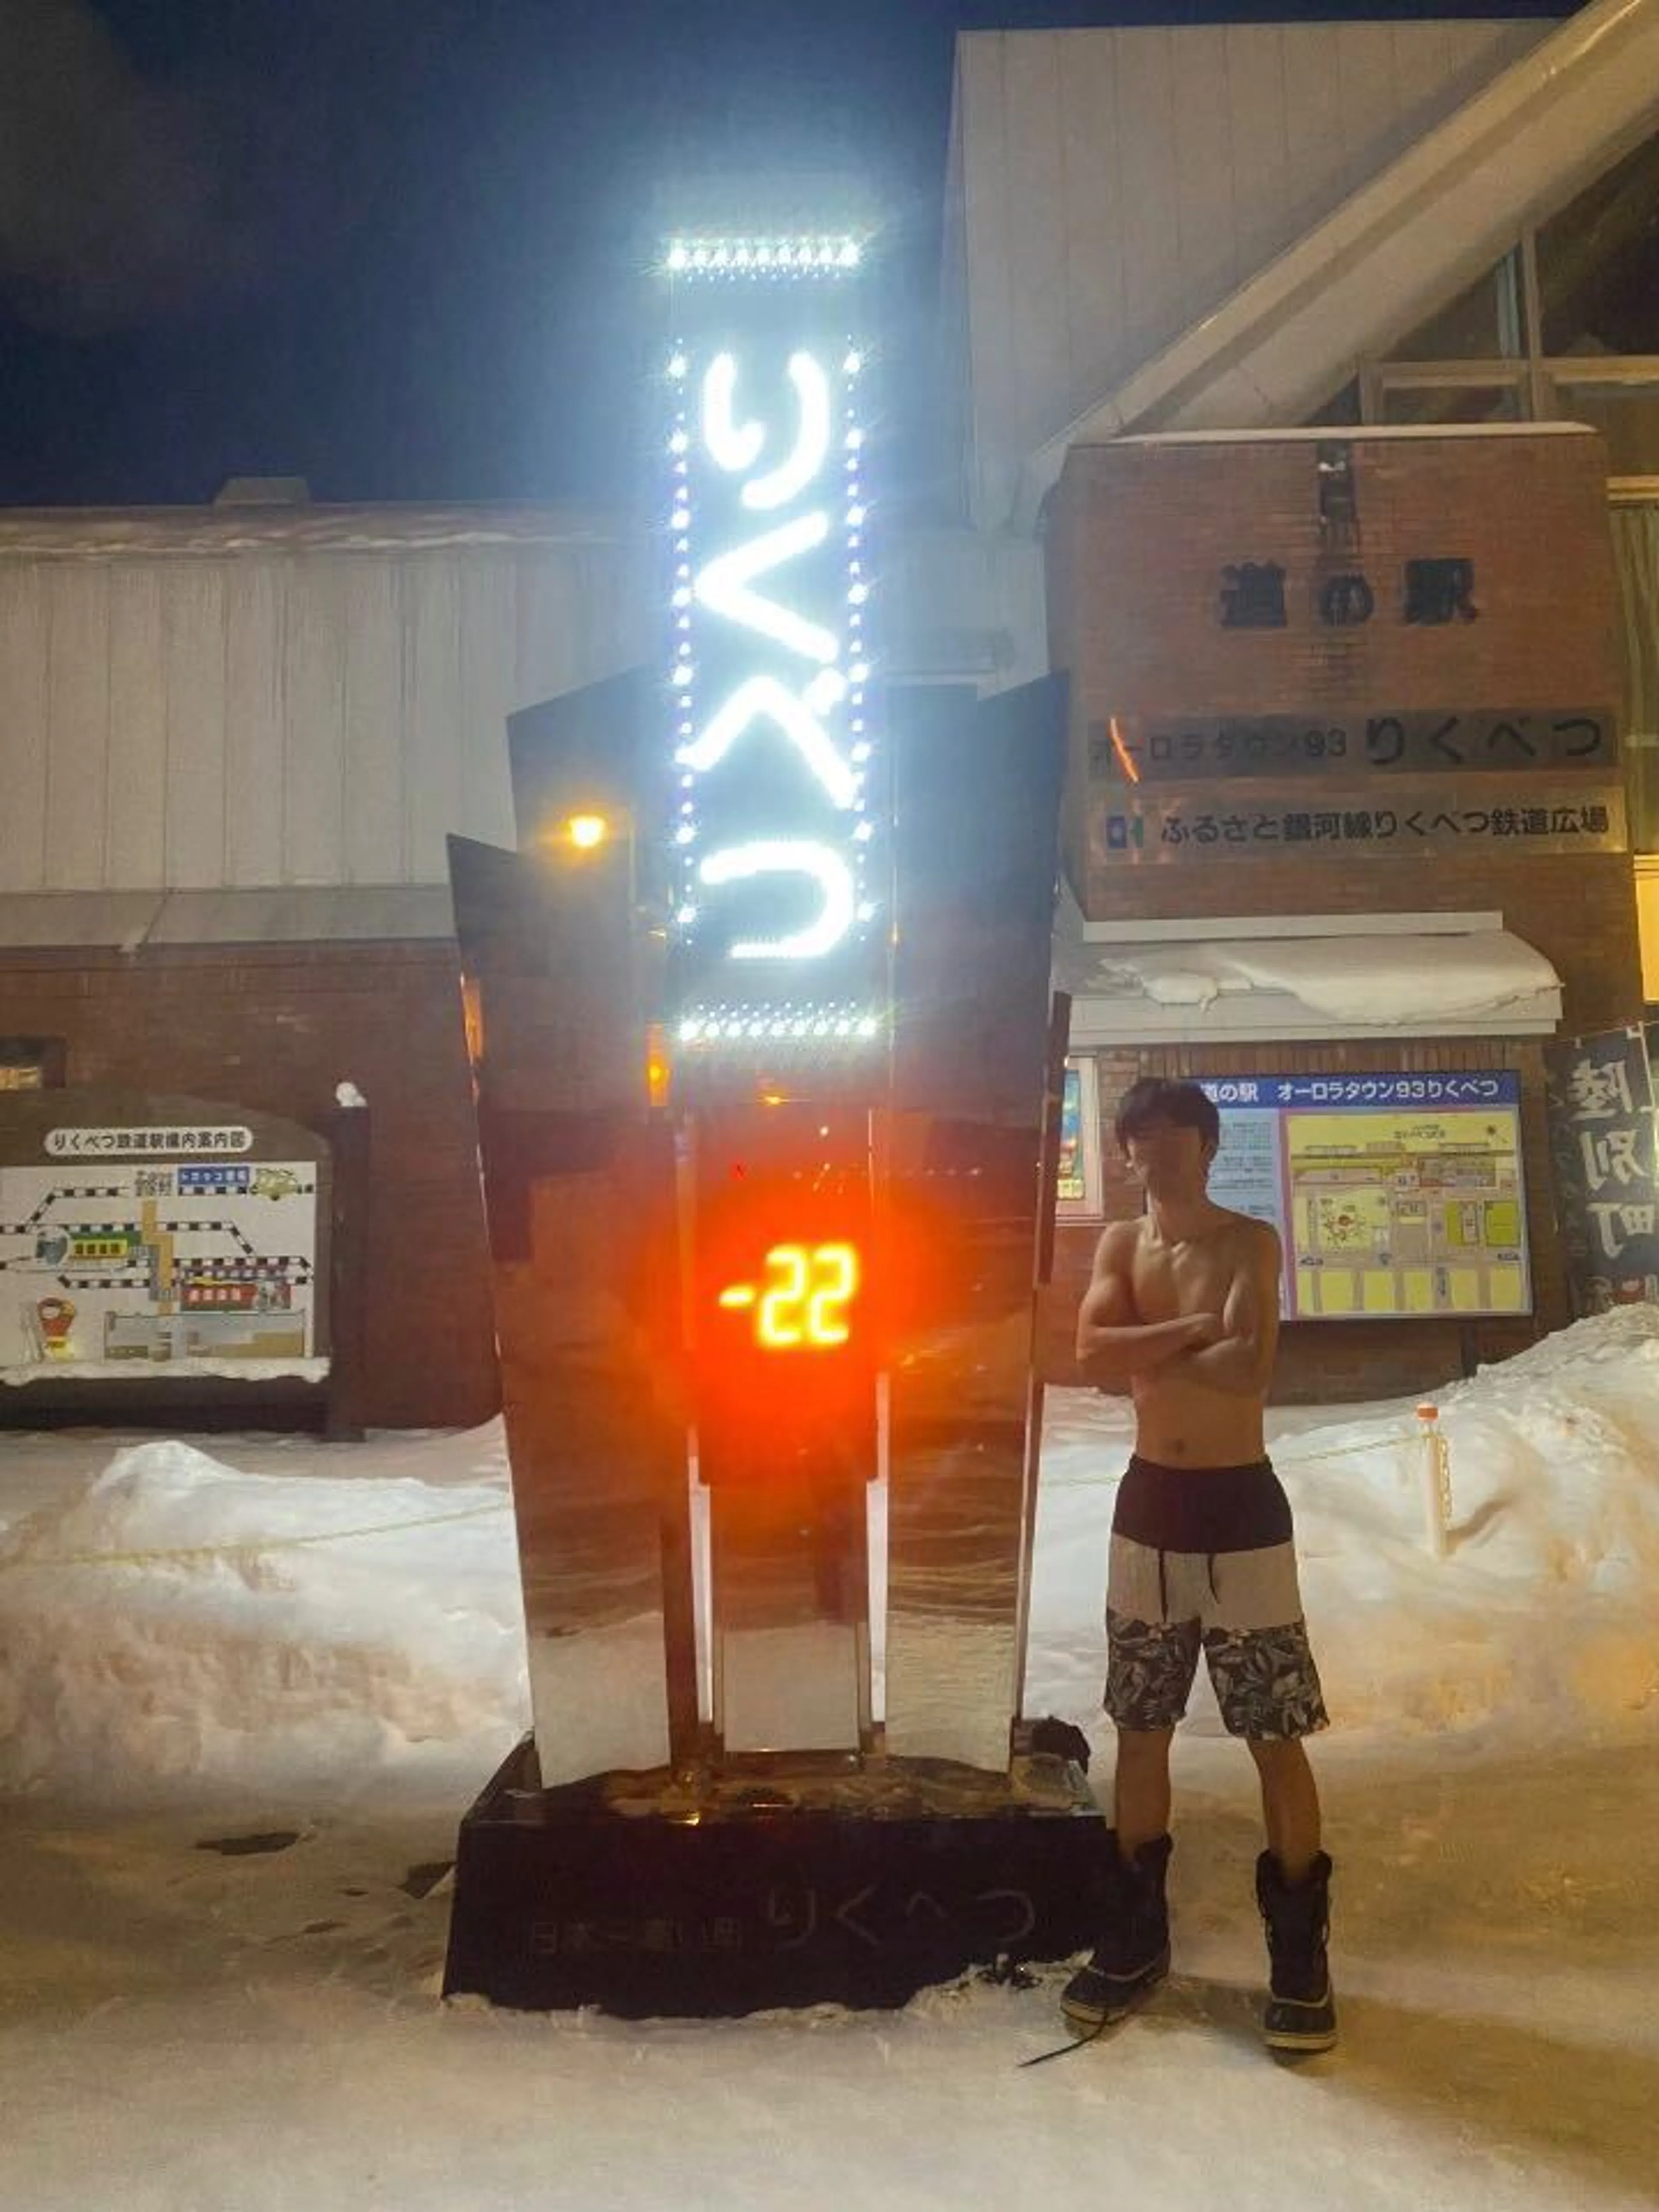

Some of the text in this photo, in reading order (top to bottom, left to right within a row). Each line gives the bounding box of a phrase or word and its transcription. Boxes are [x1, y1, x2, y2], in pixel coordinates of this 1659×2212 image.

[675, 350, 858, 958] りくべつ
[1367, 715, 1603, 765] りくべつ
[1278, 1080, 1499, 1101] オーロラタウン93りくべつ
[718, 1240, 860, 1350] -22
